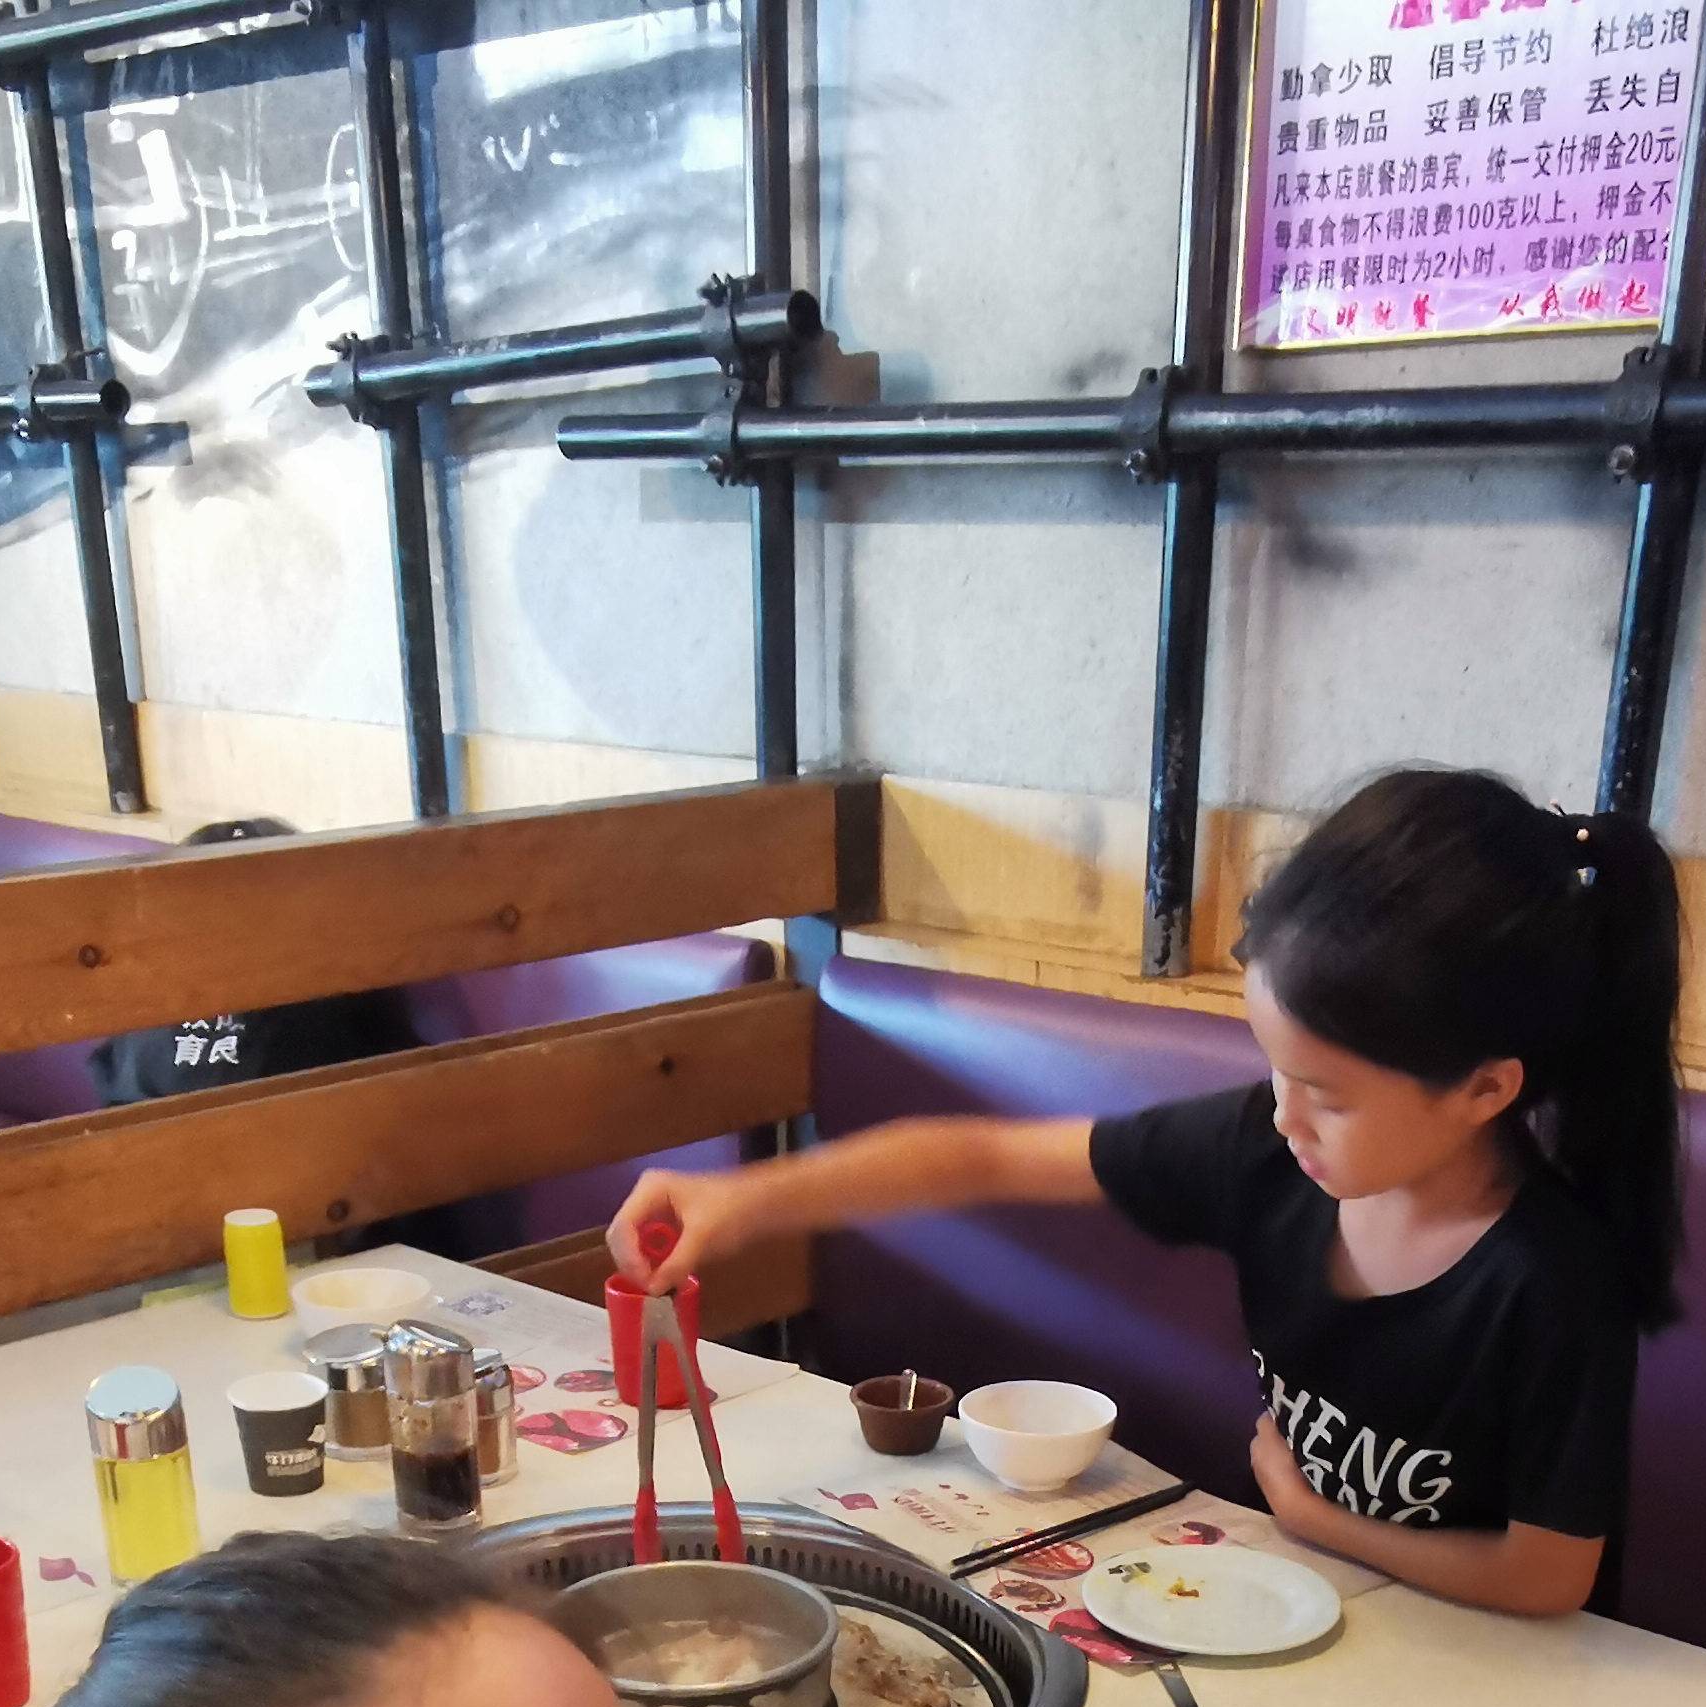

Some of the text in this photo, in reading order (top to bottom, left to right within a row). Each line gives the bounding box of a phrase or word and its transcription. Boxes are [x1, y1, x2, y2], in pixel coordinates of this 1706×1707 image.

[1279, 55, 1392, 101] 勤拿少取
[1430, 28, 1553, 80] 倡导节约
[1591, 8, 1689, 56] 杜绝浪
[1277, 67, 1681, 156] 贵重物品 妥善保管 丢失自
[1273, 126, 1682, 208] 凡来本店就餐的贵宾，统一交付押金20元
[1250, 1347, 1453, 1506] HENG
